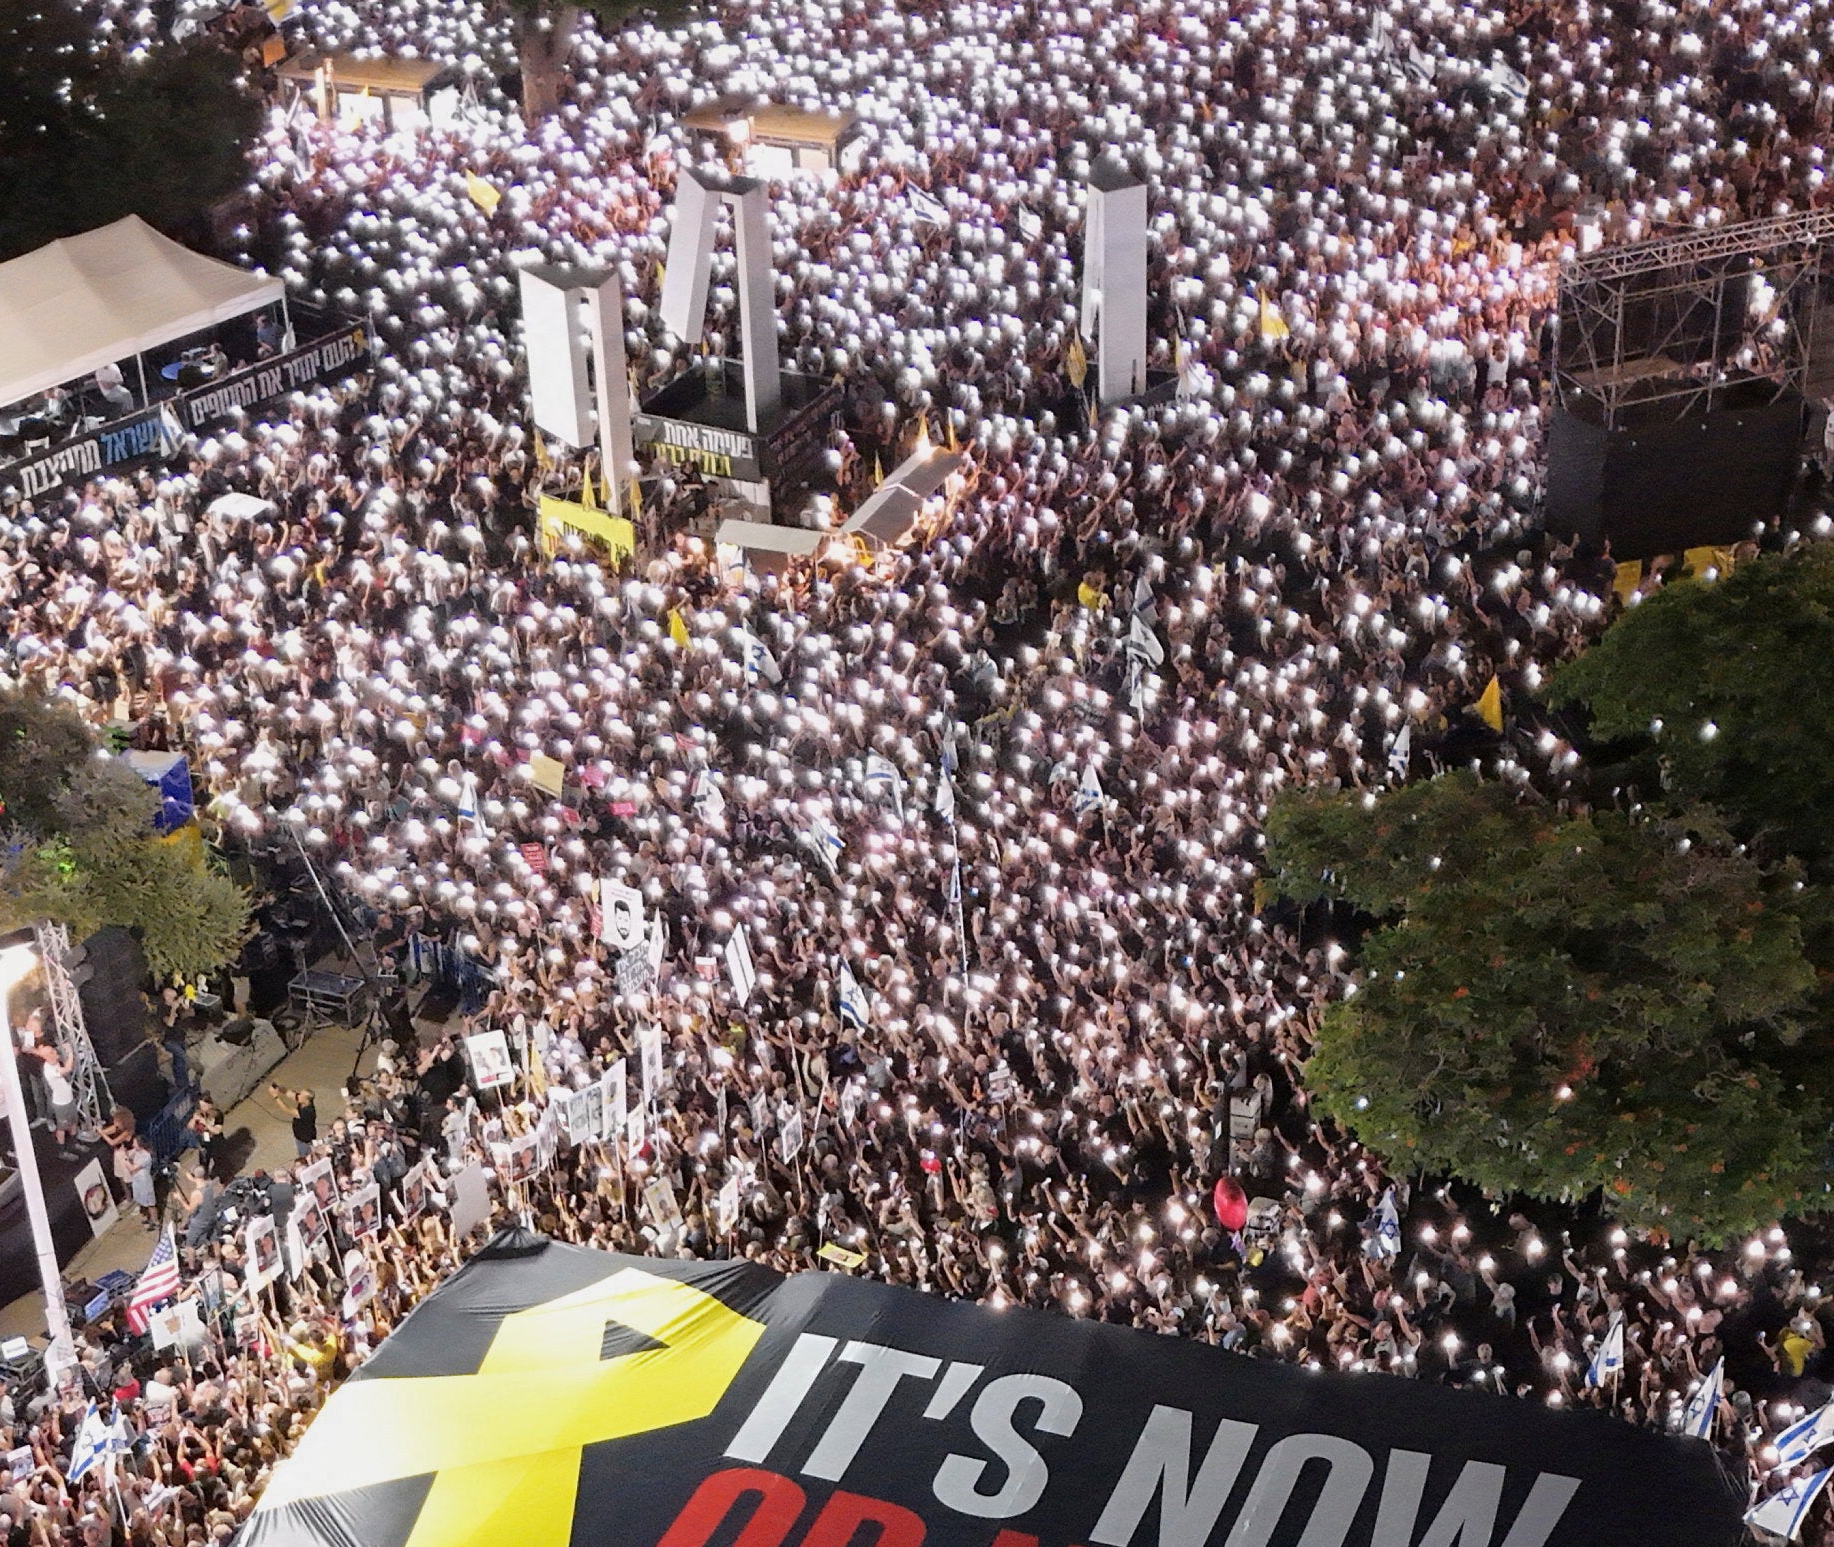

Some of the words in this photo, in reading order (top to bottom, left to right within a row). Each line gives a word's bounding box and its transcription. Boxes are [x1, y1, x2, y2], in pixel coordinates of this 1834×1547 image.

[322, 334, 354, 372] העם
[260, 367, 284, 399] את
[190, 378, 259, 426] החטופים
[664, 421, 701, 450] אחת
[703, 428, 753, 460] פעימה
[725, 1333, 1083, 1520] IT'S
